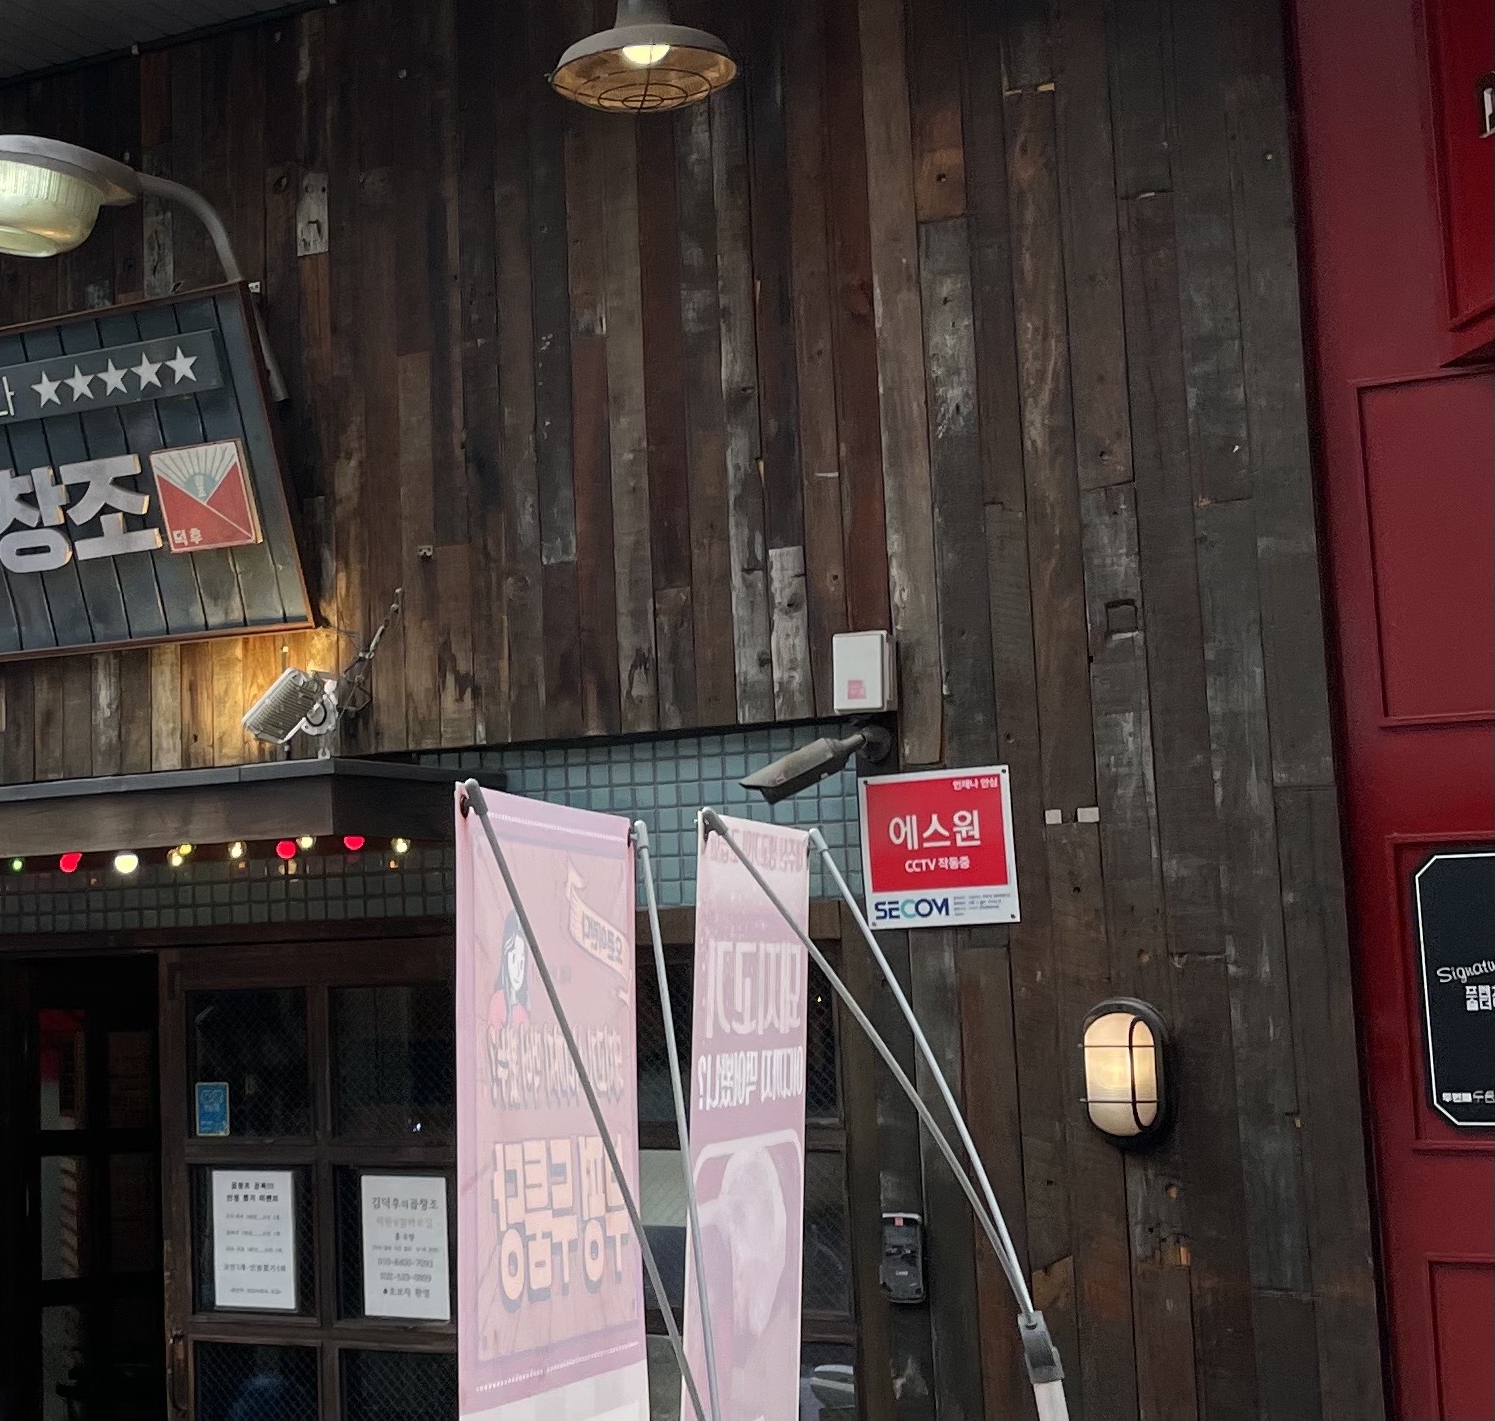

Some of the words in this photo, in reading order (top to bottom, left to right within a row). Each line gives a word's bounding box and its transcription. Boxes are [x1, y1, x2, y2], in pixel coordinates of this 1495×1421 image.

[952, 778, 978, 791] 언제나
[889, 809, 981, 851] 에스원
[905, 858, 936, 873] CCTV
[938, 855, 970, 870] 작동중
[874, 897, 950, 920] SECOM
